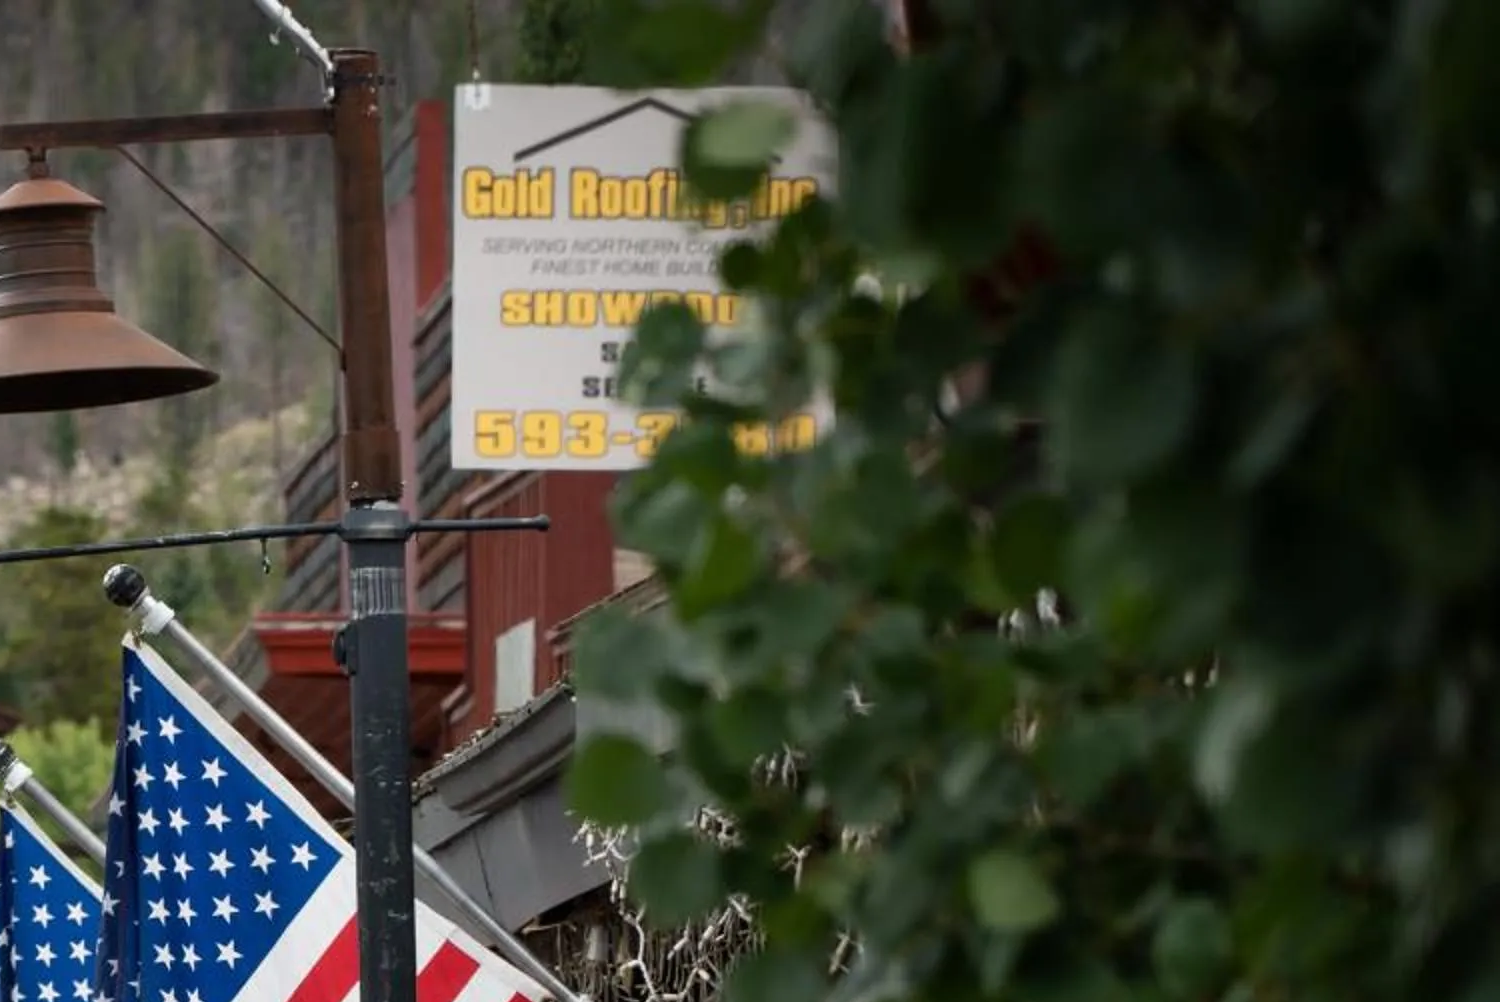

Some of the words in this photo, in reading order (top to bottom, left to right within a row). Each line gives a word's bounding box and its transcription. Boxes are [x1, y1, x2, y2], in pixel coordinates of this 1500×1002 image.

[463, 166, 554, 220] Gold
[481, 237, 567, 255] SERVING
[571, 237, 681, 255] NORTHERN
[529, 257, 598, 276] FINEST
[603, 258, 661, 276] HOME
